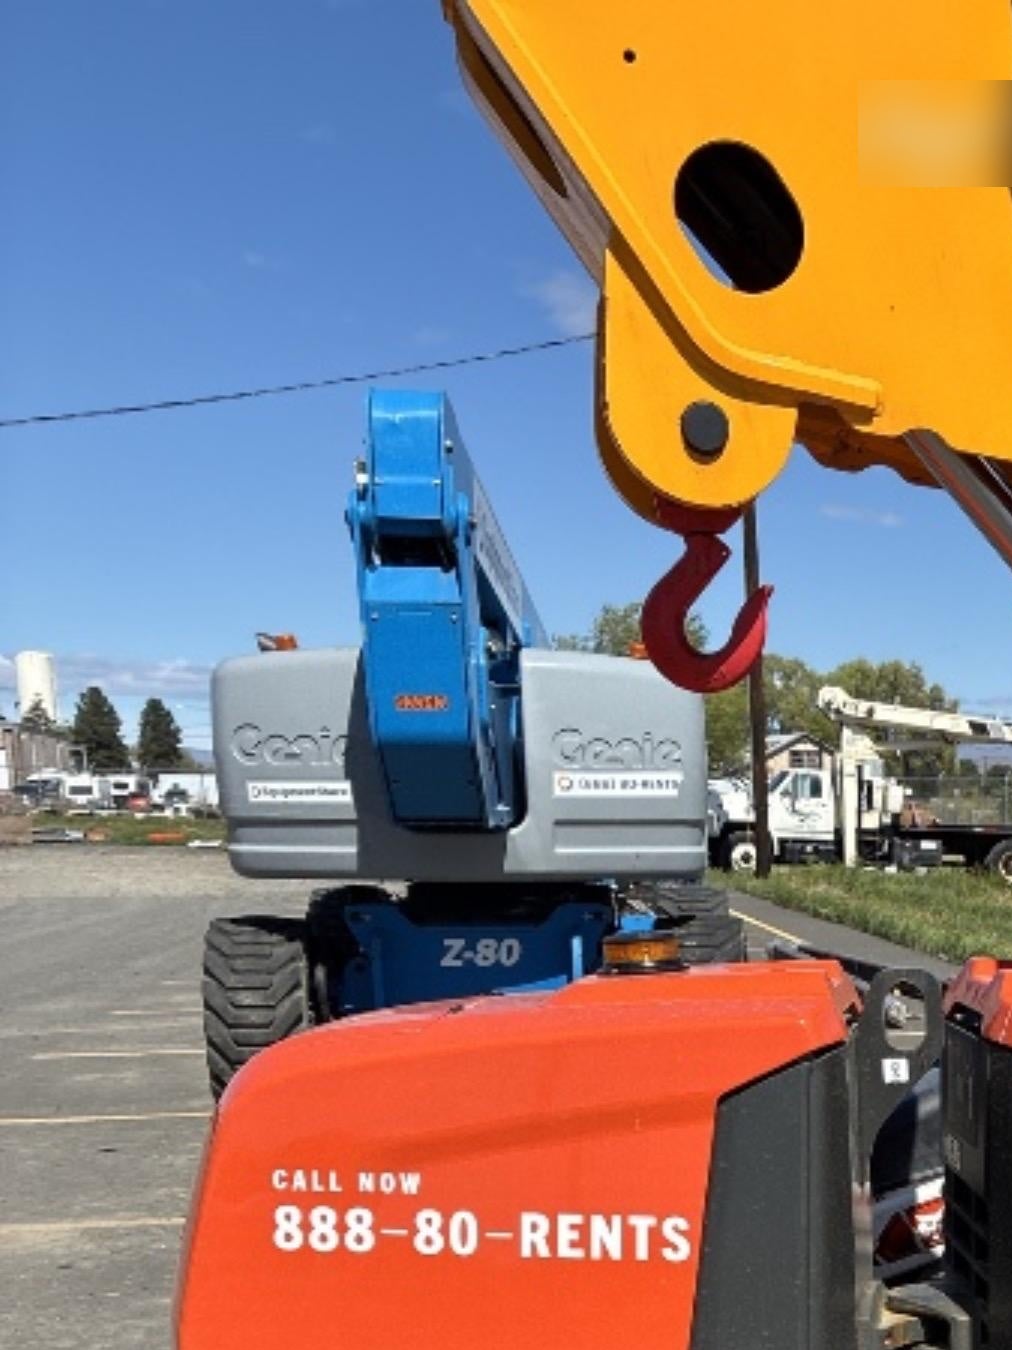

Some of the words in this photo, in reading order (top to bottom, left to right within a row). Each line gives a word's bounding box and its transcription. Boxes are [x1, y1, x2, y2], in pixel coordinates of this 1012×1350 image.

[551, 728, 683, 769] Genie
[440, 938, 520, 967] Z-80
[272, 1168, 343, 1193] CALL
[358, 1172, 421, 1195] NOW
[273, 1204, 691, 1262] 888-80-RENTS
